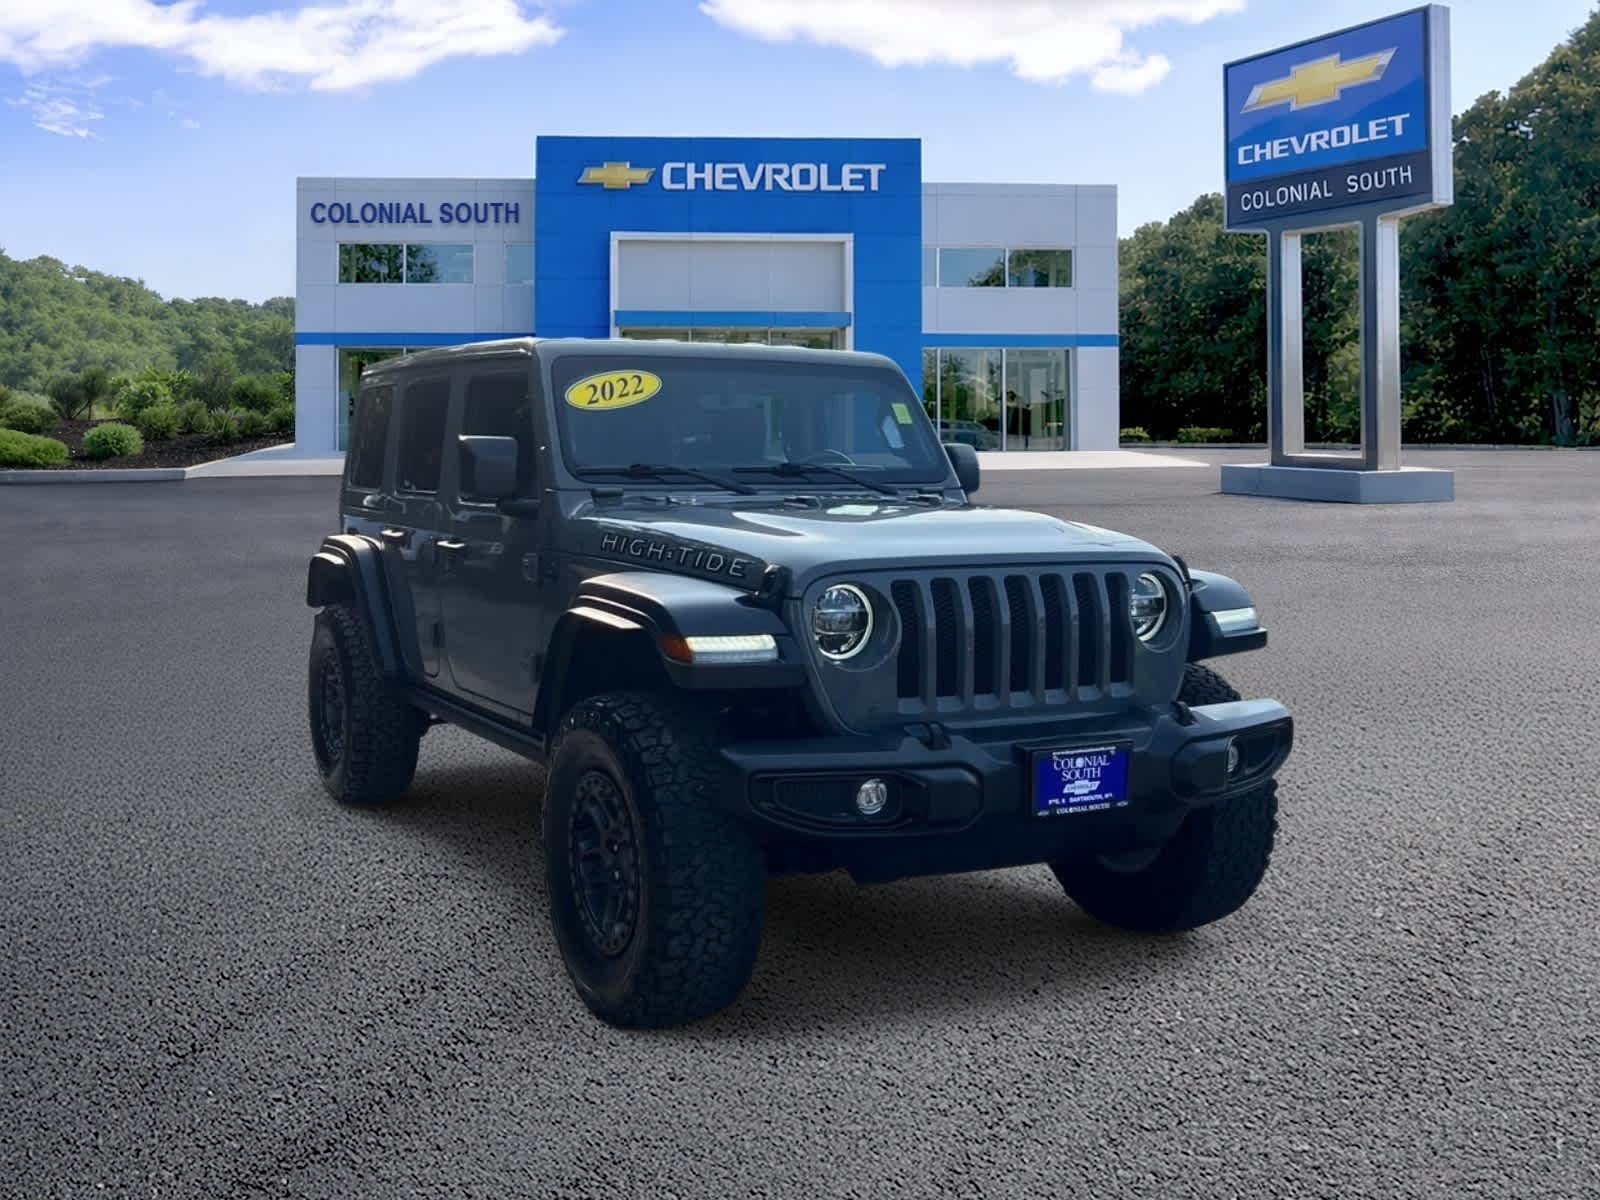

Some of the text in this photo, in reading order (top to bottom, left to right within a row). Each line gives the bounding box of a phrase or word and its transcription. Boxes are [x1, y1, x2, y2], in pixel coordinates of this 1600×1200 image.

[1238, 113, 1410, 165] CHEVROLET
[662, 161, 887, 192] CHEVROLET
[1241, 164, 1413, 212] COLONIAL SOUTH
[310, 202, 521, 225] COLONIAL SOUTH
[586, 374, 645, 405] 2022
[1053, 754, 1111, 771] COLONIAL
[1062, 767, 1101, 781] SOUTH
